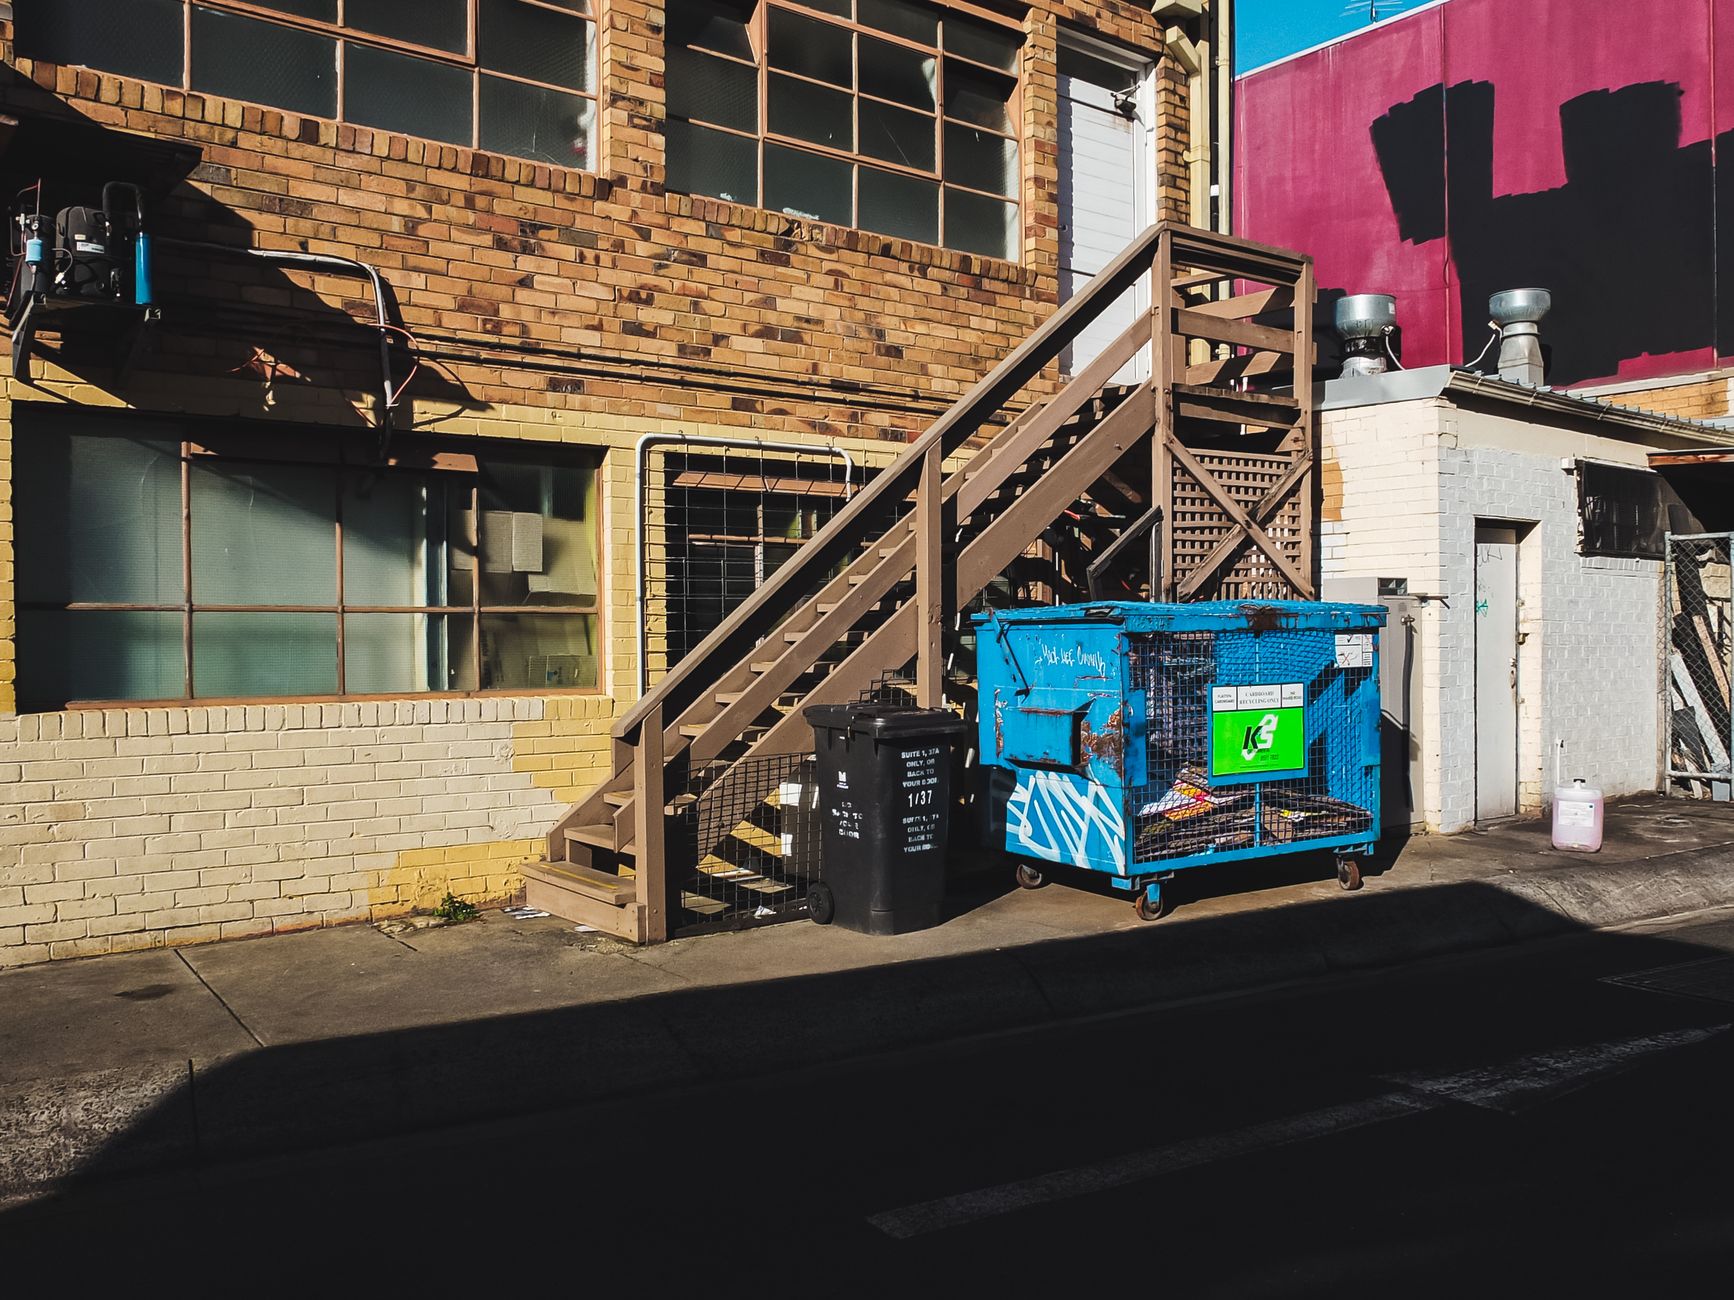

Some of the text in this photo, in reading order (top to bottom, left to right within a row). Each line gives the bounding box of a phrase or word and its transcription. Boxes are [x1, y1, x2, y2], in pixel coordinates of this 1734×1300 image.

[901, 750, 921, 759] SUITE
[902, 780, 921, 788] YOUR
[908, 790, 933, 808] 1/37
